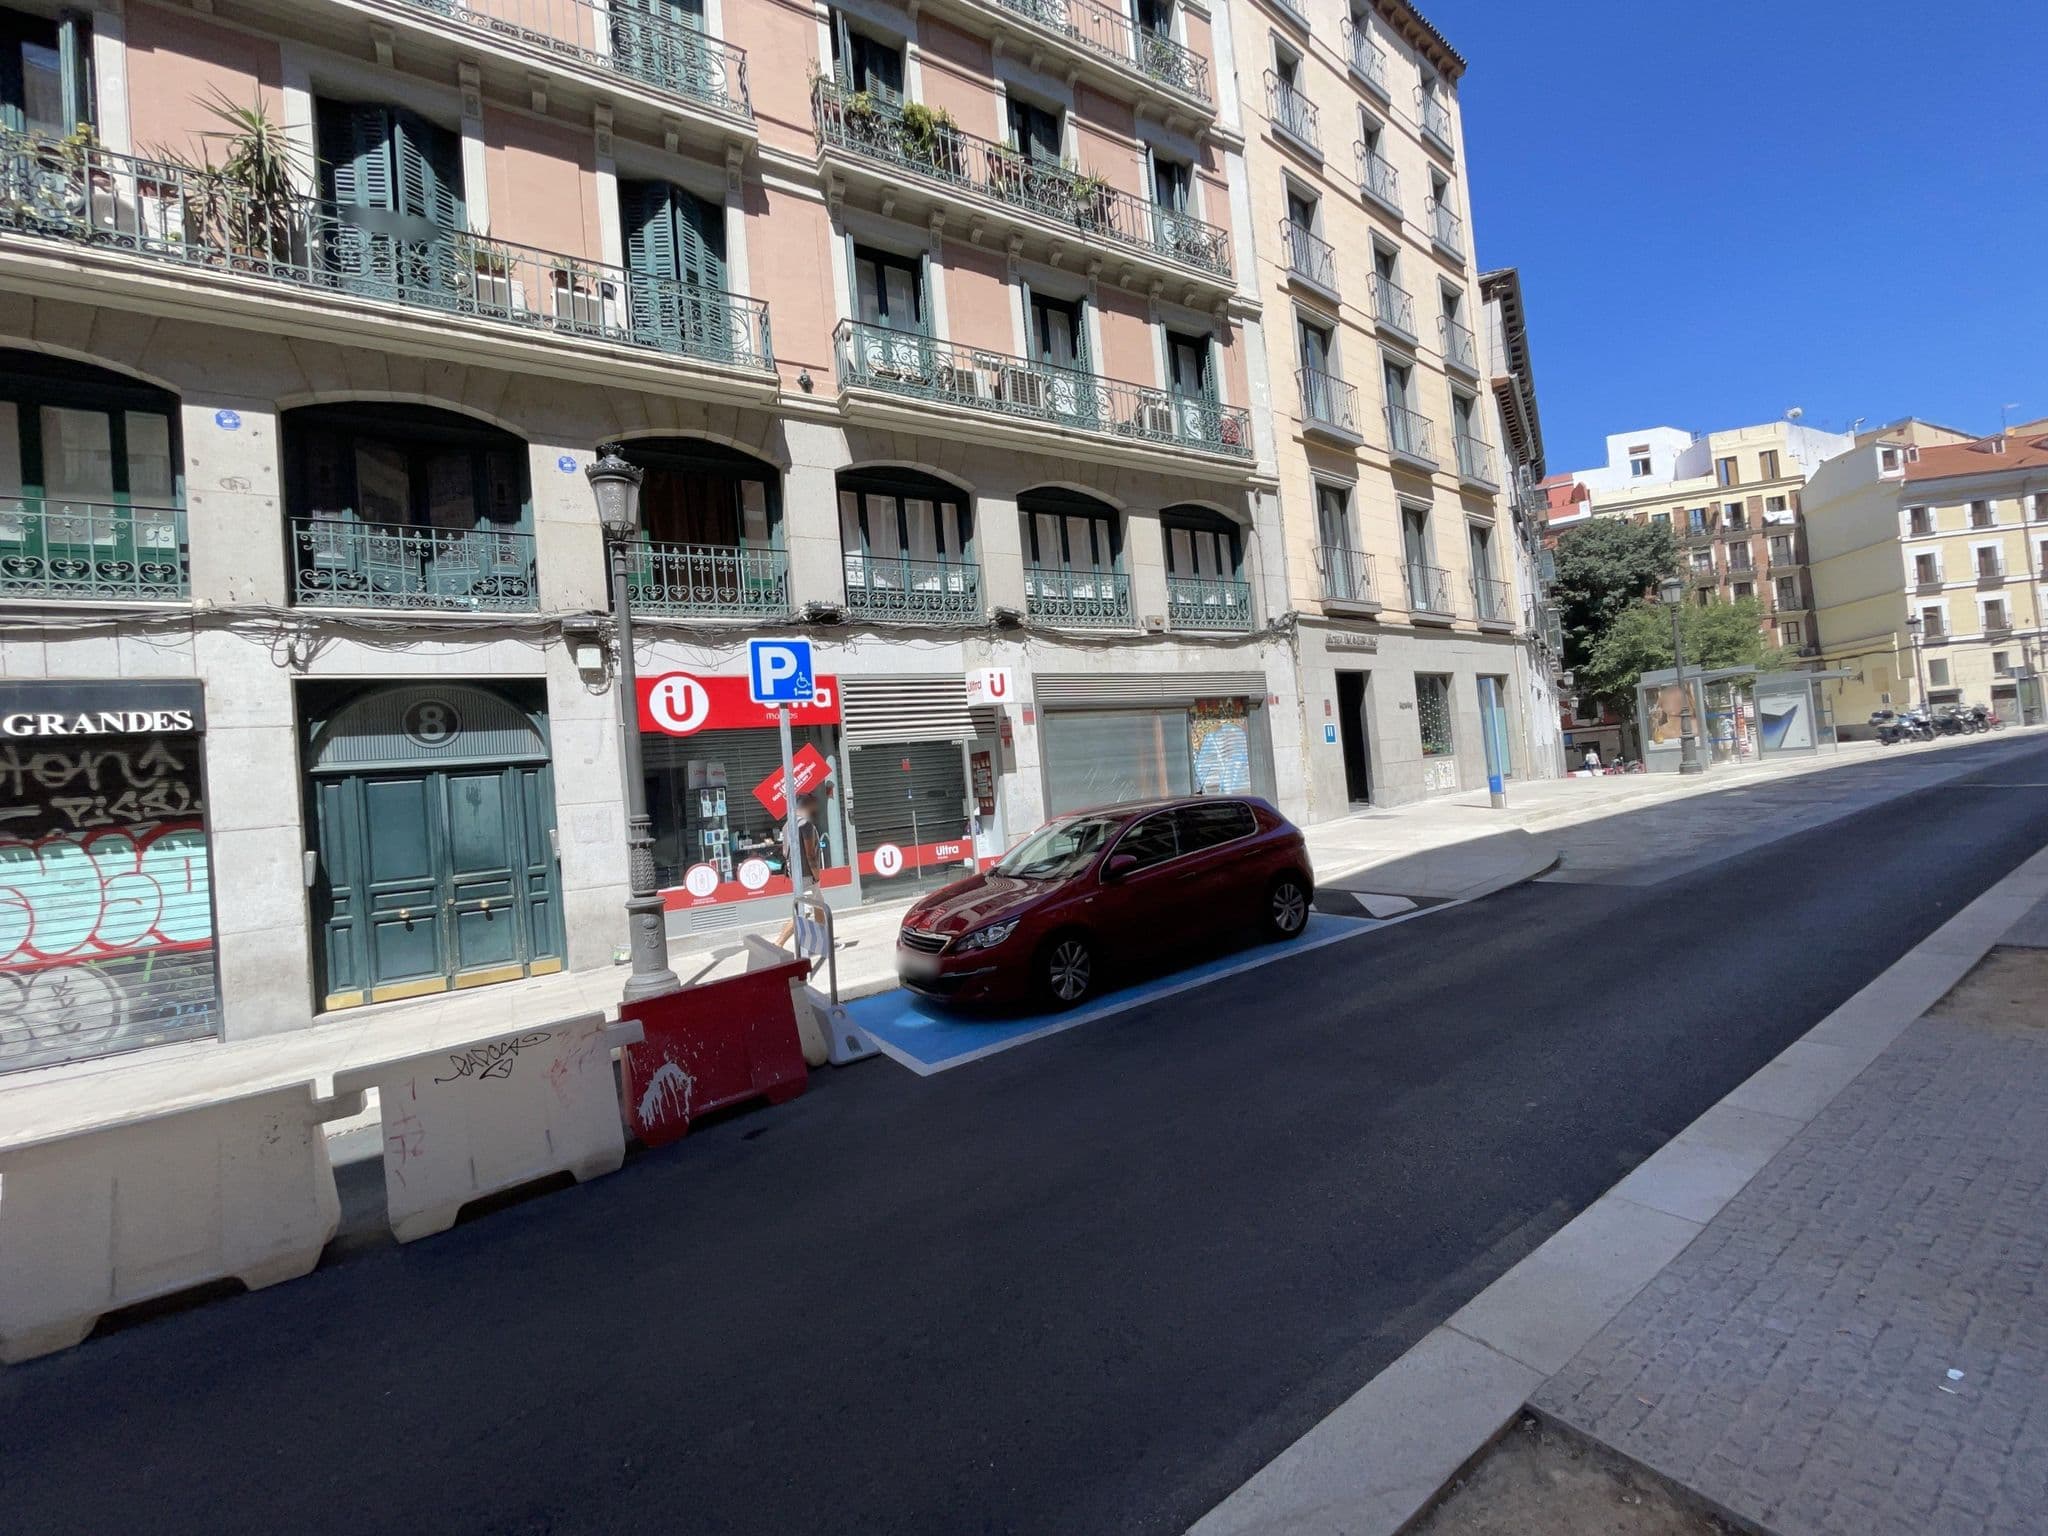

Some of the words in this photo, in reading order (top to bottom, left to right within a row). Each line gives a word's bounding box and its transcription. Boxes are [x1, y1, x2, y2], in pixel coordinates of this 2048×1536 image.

[759, 646, 798, 695] P
[2, 710, 194, 736] GRANDES
[419, 706, 446, 740] 8
[935, 845, 959, 856] Ultra
